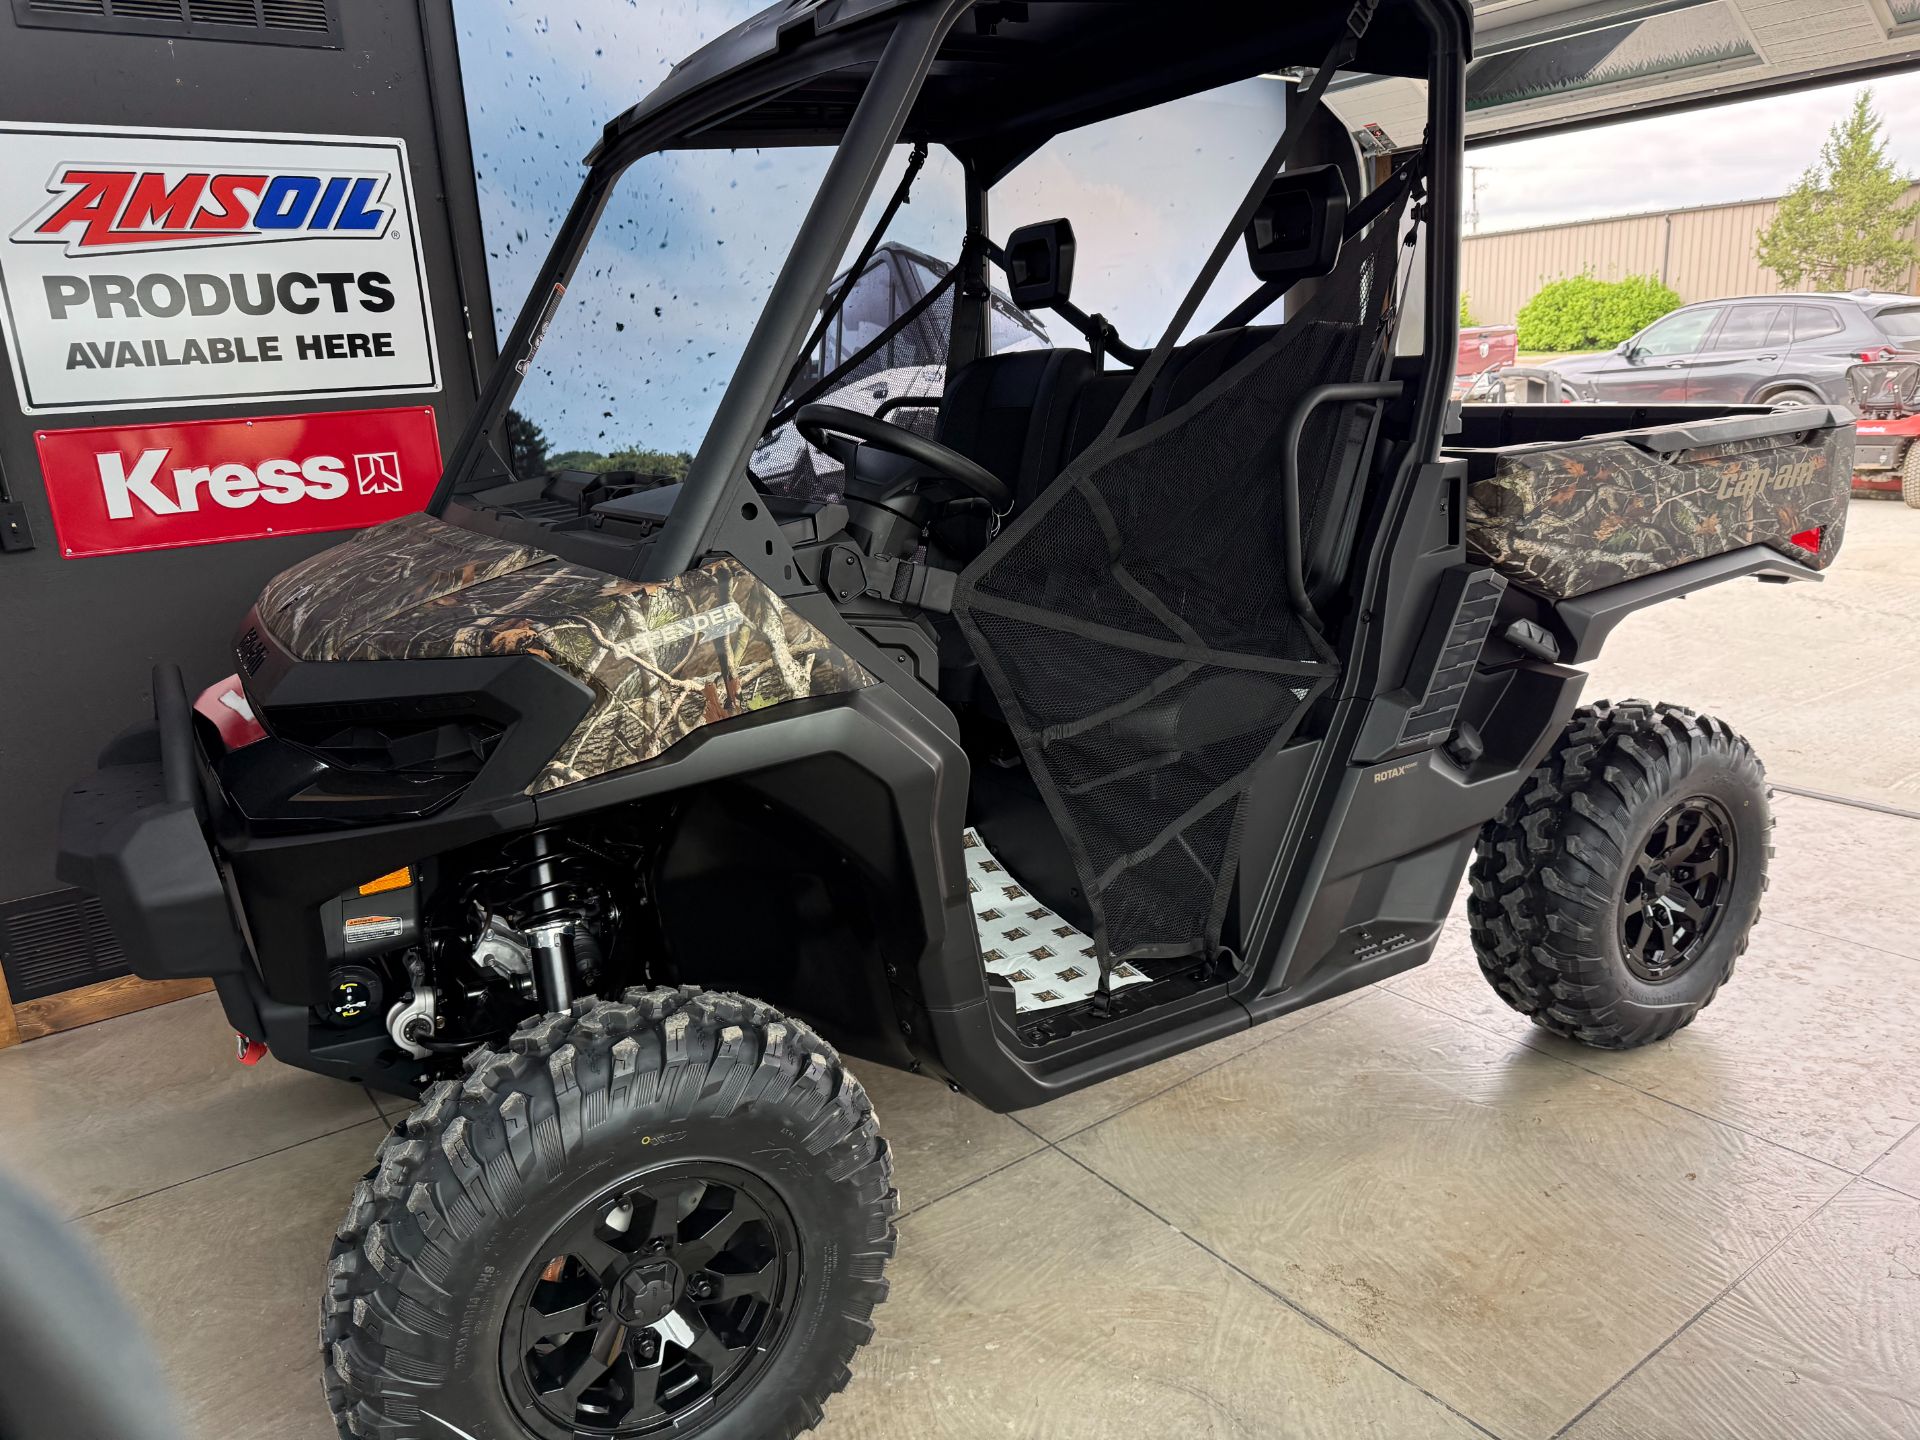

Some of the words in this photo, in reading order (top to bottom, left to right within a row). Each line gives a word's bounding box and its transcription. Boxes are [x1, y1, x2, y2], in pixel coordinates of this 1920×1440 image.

[35, 170, 384, 247] AMSOIL
[42, 272, 395, 319] PRODUCTS
[65, 335, 284, 370] AVAILABLE
[296, 332, 396, 361] HERE
[96, 448, 350, 520] Kress
[614, 603, 742, 656] DEFENDER
[1374, 765, 1405, 784] ROTAX
